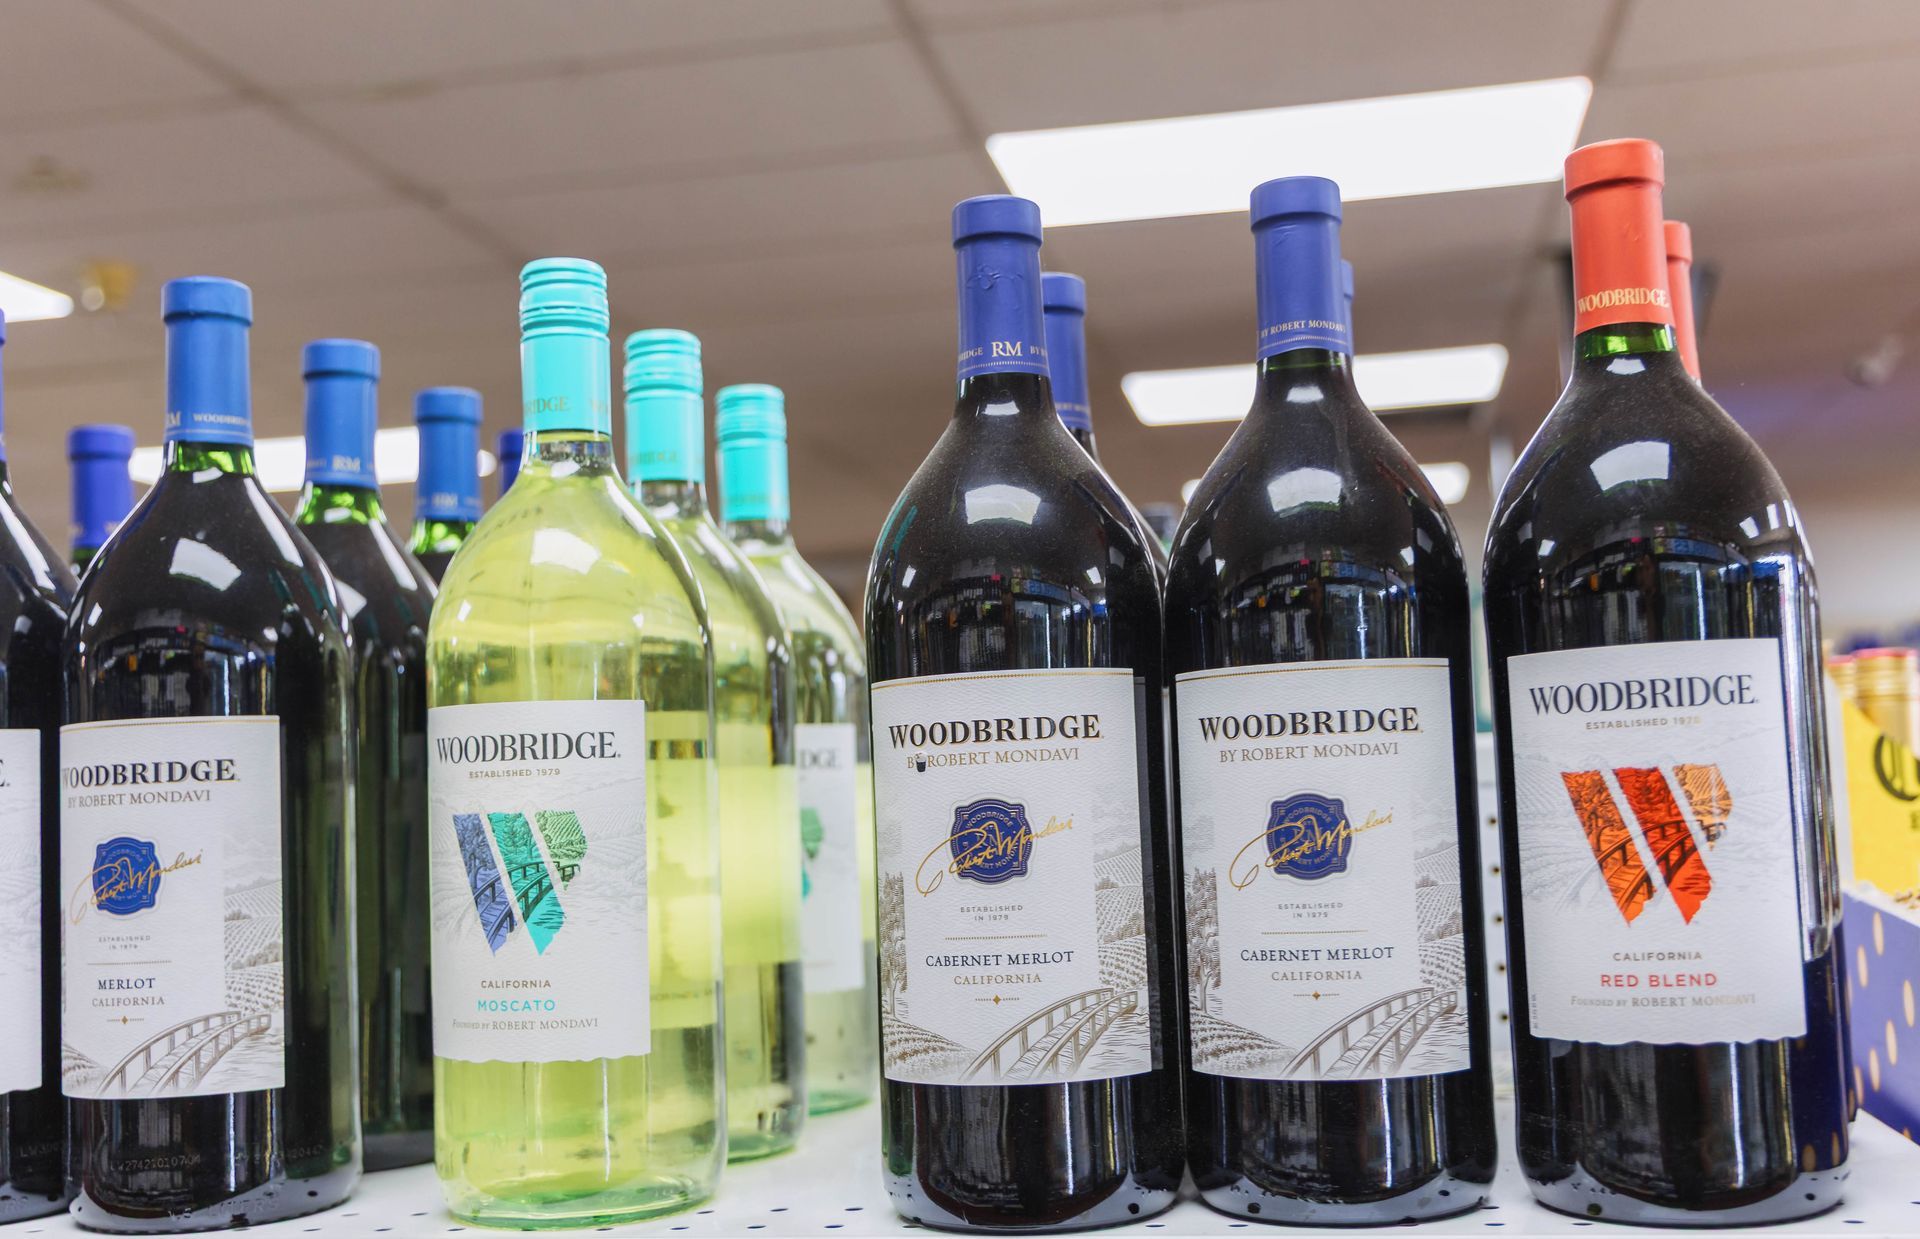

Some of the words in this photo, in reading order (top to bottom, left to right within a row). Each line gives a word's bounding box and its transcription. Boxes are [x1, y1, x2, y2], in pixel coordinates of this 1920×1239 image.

[1578, 287, 1669, 313] WOODBRIDGE
[1270, 320, 1306, 334] ROBERT
[991, 341, 1023, 358] RM
[1030, 345, 1041, 355] BY
[1529, 674, 1756, 716] WOODBRIDGE
[1198, 706, 1424, 744] WOODBRIDGE
[1585, 718, 1668, 731] ESTABLISHED
[888, 714, 1103, 749] WOODBRIDGE
[927, 751, 990, 768] ROBERT
[995, 747, 1080, 764] MONDAVI
[1219, 750, 1237, 763] BY
[1241, 746, 1308, 762] ROBERT
[1313, 742, 1399, 758] MONDAVI
[469, 769, 533, 779] ESTABLISHED
[537, 768, 561, 776] 1979
[79, 793, 126, 808] ROBERT
[130, 789, 211, 805] MONDAVI
[960, 904, 1023, 913] ESTABLISHED
[1278, 902, 1343, 910] ESTABLISHED
[925, 954, 1002, 967] CABERNET
[1007, 950, 1074, 966] MERLOT
[1240, 949, 1321, 962] CABERNET
[1327, 946, 1394, 961] MERLOT
[1613, 951, 1702, 962] CALIFORNIA
[953, 973, 1042, 985] CALIFORNIA
[1271, 970, 1362, 981] CALIFORNIA
[1600, 974, 1639, 988] RED
[1648, 973, 1717, 988] BLEND
[98, 977, 156, 990] MERLOT
[480, 979, 552, 989] CALIFORNIA
[91, 996, 165, 1008] CALIFORNIA
[477, 999, 556, 1012] MOSCATO
[1632, 996, 1687, 1008] ROBERT
[492, 1020, 536, 1031] ROBERT
[540, 1017, 599, 1030] MONDAVI
